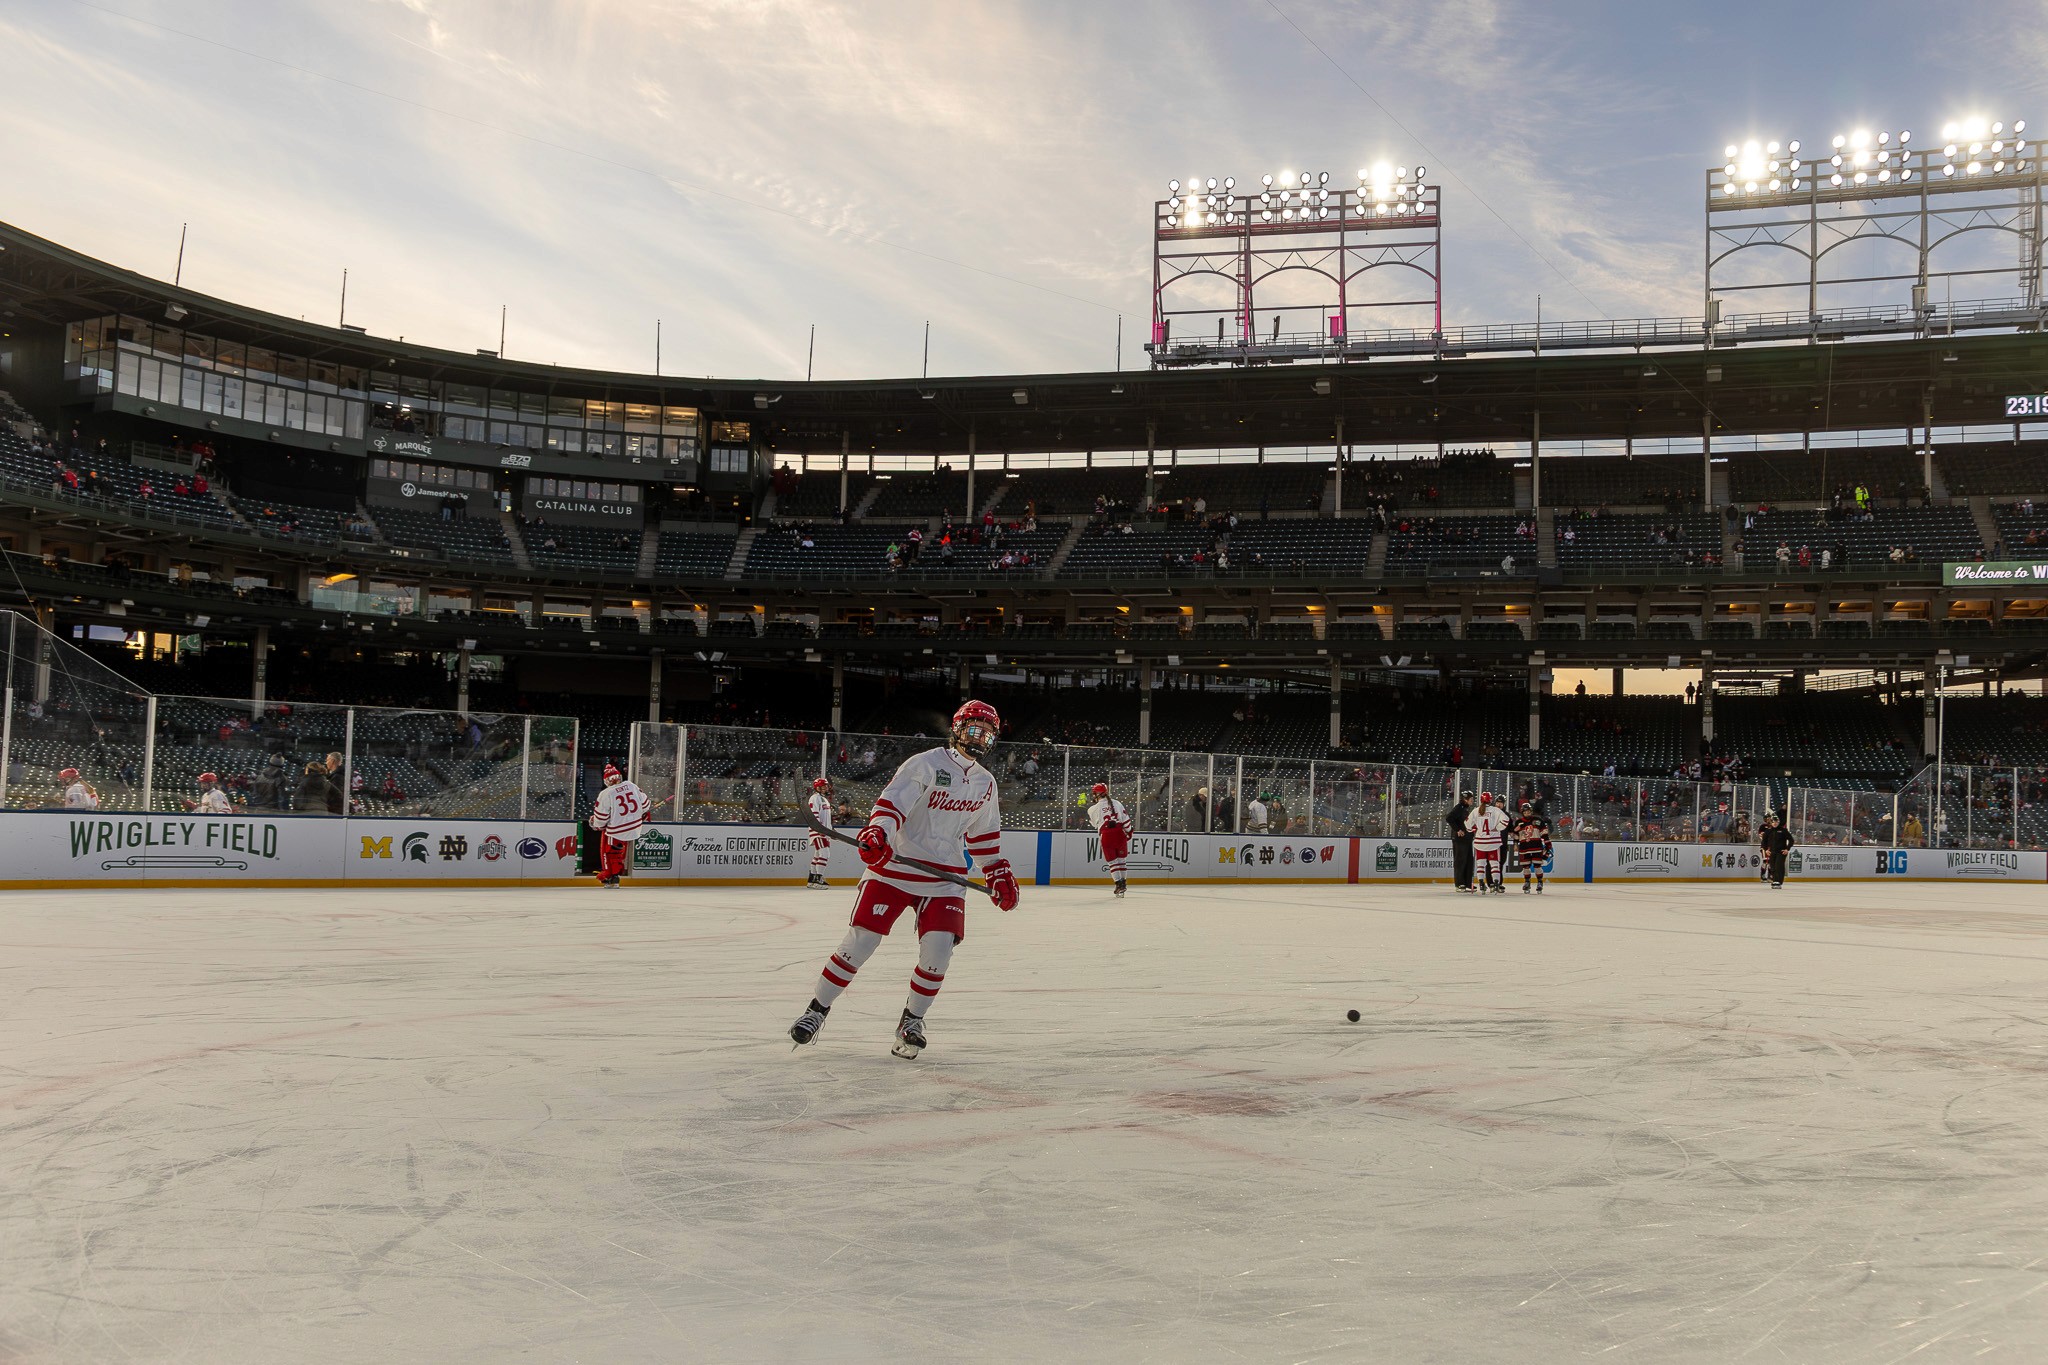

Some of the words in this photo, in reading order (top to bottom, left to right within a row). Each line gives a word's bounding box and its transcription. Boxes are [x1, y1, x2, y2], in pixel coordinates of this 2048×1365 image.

[395, 442, 432, 455] MARQUEE
[510, 454, 531, 462] 670
[536, 500, 596, 513] CATALINA
[601, 505, 633, 515] CLUB
[1955, 564, 2012, 579] Welcome
[2015, 567, 2029, 578] to
[2032, 565, 2048, 579] W
[983, 781, 993, 801] A
[616, 791, 638, 816] 35
[1482, 818, 1490, 835] 4
[70, 820, 196, 858] WRIGLEY
[206, 822, 278, 859] FIELD
[360, 836, 393, 858] M
[635, 837, 670, 850] Frozen
[682, 837, 722, 851] Frozen
[727, 838, 808, 851] CONFINES
[1153, 838, 1189, 863] FIELD
[1219, 847, 1236, 863] M
[1618, 846, 1654, 866] WRIGLEY
[1657, 846, 1679, 866] FIELD
[697, 855, 711, 865] BIG
[714, 855, 729, 865] TEN
[732, 855, 763, 865] HOCKEY
[766, 855, 794, 865] SERIES
[1420, 860, 1428, 868] TEN
[1947, 852, 1987, 868] WRIGLEY
[1990, 853, 2018, 870] FIELD
[946, 905, 963, 914] CCM
